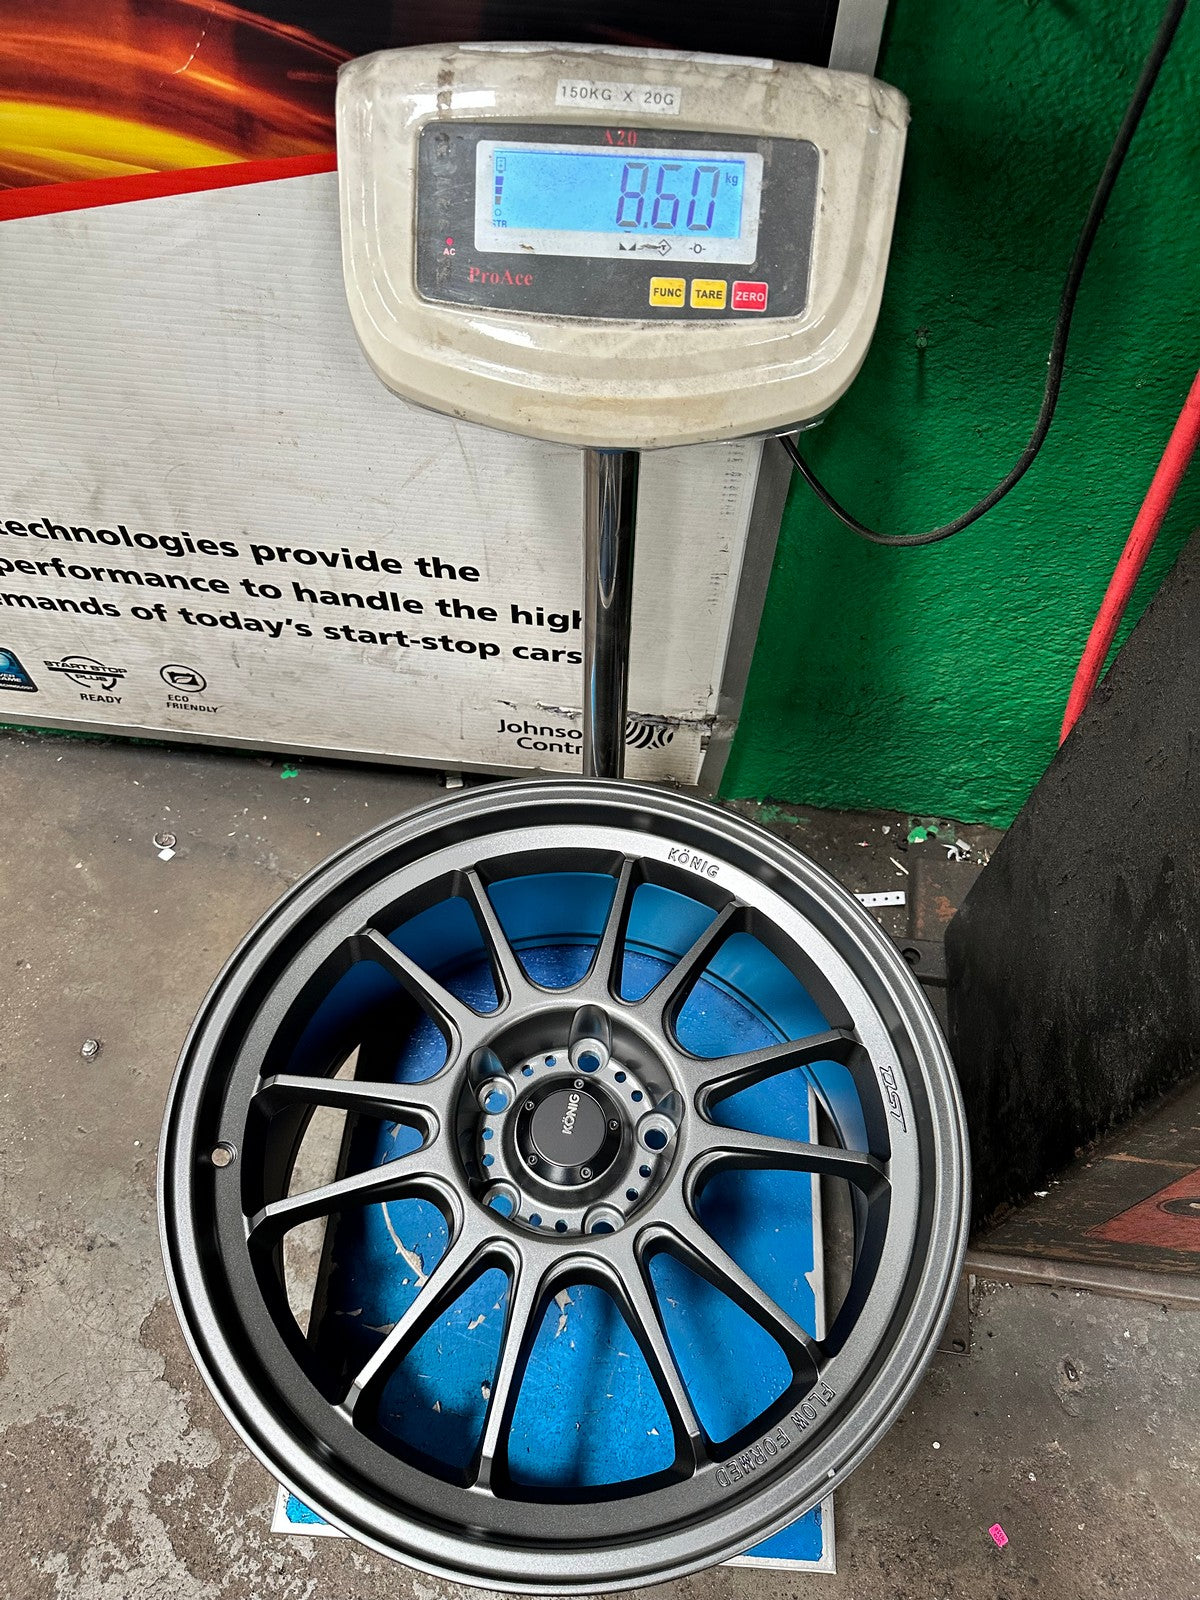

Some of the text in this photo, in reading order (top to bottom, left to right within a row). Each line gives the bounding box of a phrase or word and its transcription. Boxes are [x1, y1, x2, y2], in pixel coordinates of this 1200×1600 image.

[561, 86, 675, 106] 150KG X 20G
[602, 129, 638, 146] A20
[616, 162, 739, 230] 8.60 kg
[443, 248, 456, 256] AC
[468, 266, 534, 287] ProAce
[653, 287, 682, 298] FUNC
[695, 289, 723, 300] TARE
[735, 291, 765, 302] ZERO
[250, 543, 403, 575] provide
[414, 556, 481, 583] the
[0, 557, 230, 595] performance
[240, 578, 283, 600] to
[291, 581, 424, 615] handle
[435, 598, 498, 623] the
[0, 592, 583, 665] mands of today's start-stop cars
[43, 660, 128, 674] START STOP
[75, 673, 108, 682] PLUS
[80, 692, 122, 704] READY
[166, 701, 219, 713] FRIENDLY
[168, 694, 189, 703] ECO
[498, 718, 583, 740] Johnso
[516, 736, 583, 755] Contr
[668, 847, 720, 878] KÖNIG
[561, 1093, 580, 1135] KÖNIG
[715, 1381, 836, 1487] FLOW FORMED
